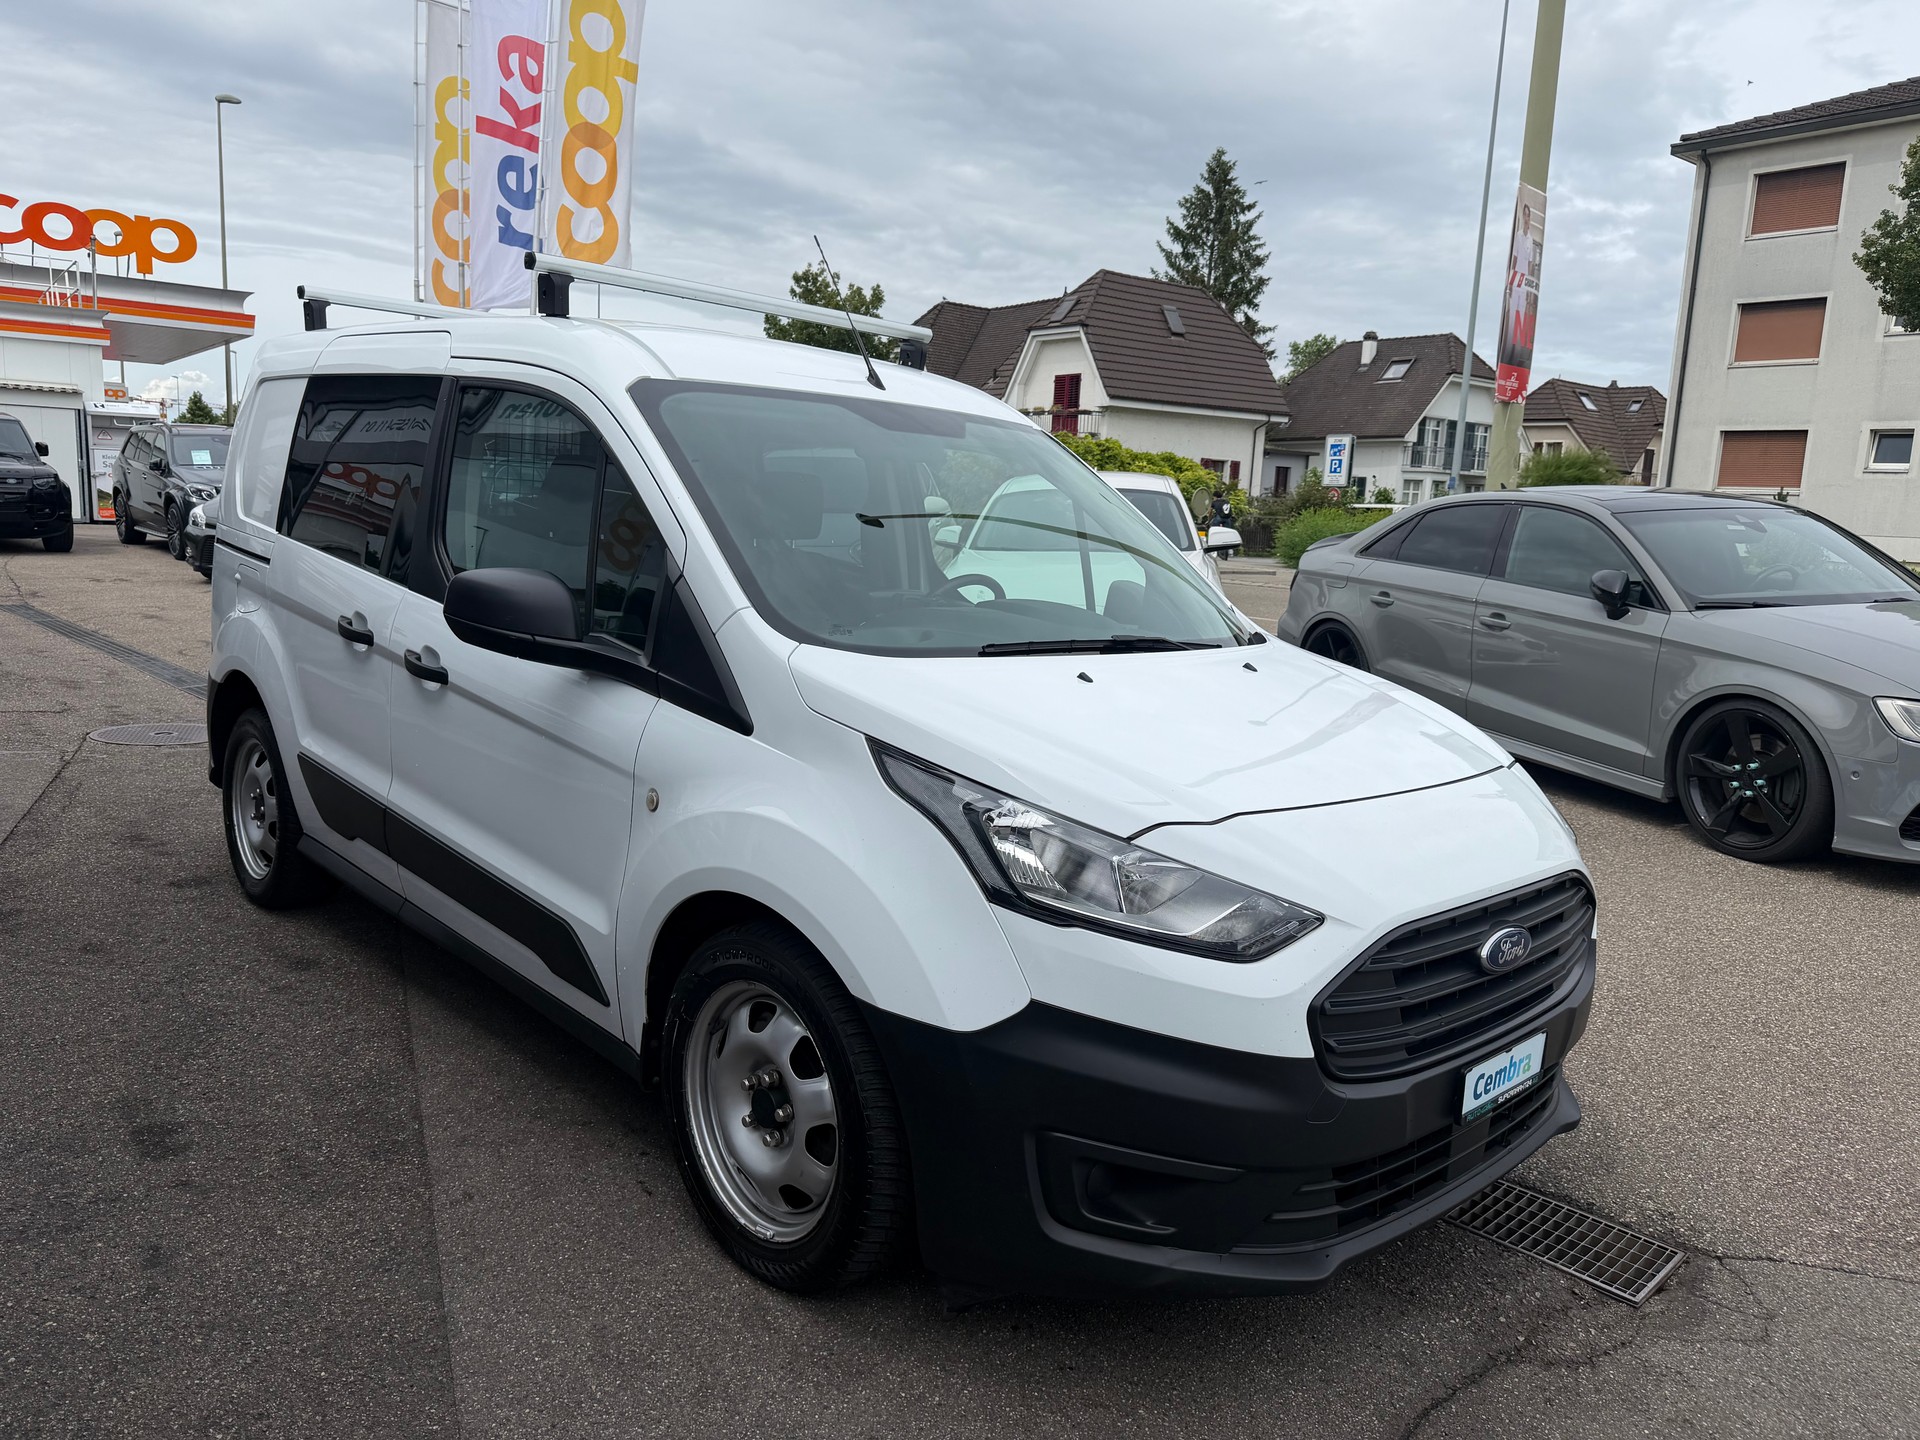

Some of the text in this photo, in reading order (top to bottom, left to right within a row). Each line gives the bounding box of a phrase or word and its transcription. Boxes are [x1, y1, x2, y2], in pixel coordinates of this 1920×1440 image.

[475, 34, 546, 252] reka
[556, 0, 638, 265] coop
[1498, 935, 1525, 964] Ford
[1473, 1053, 1532, 1100] Cembra
